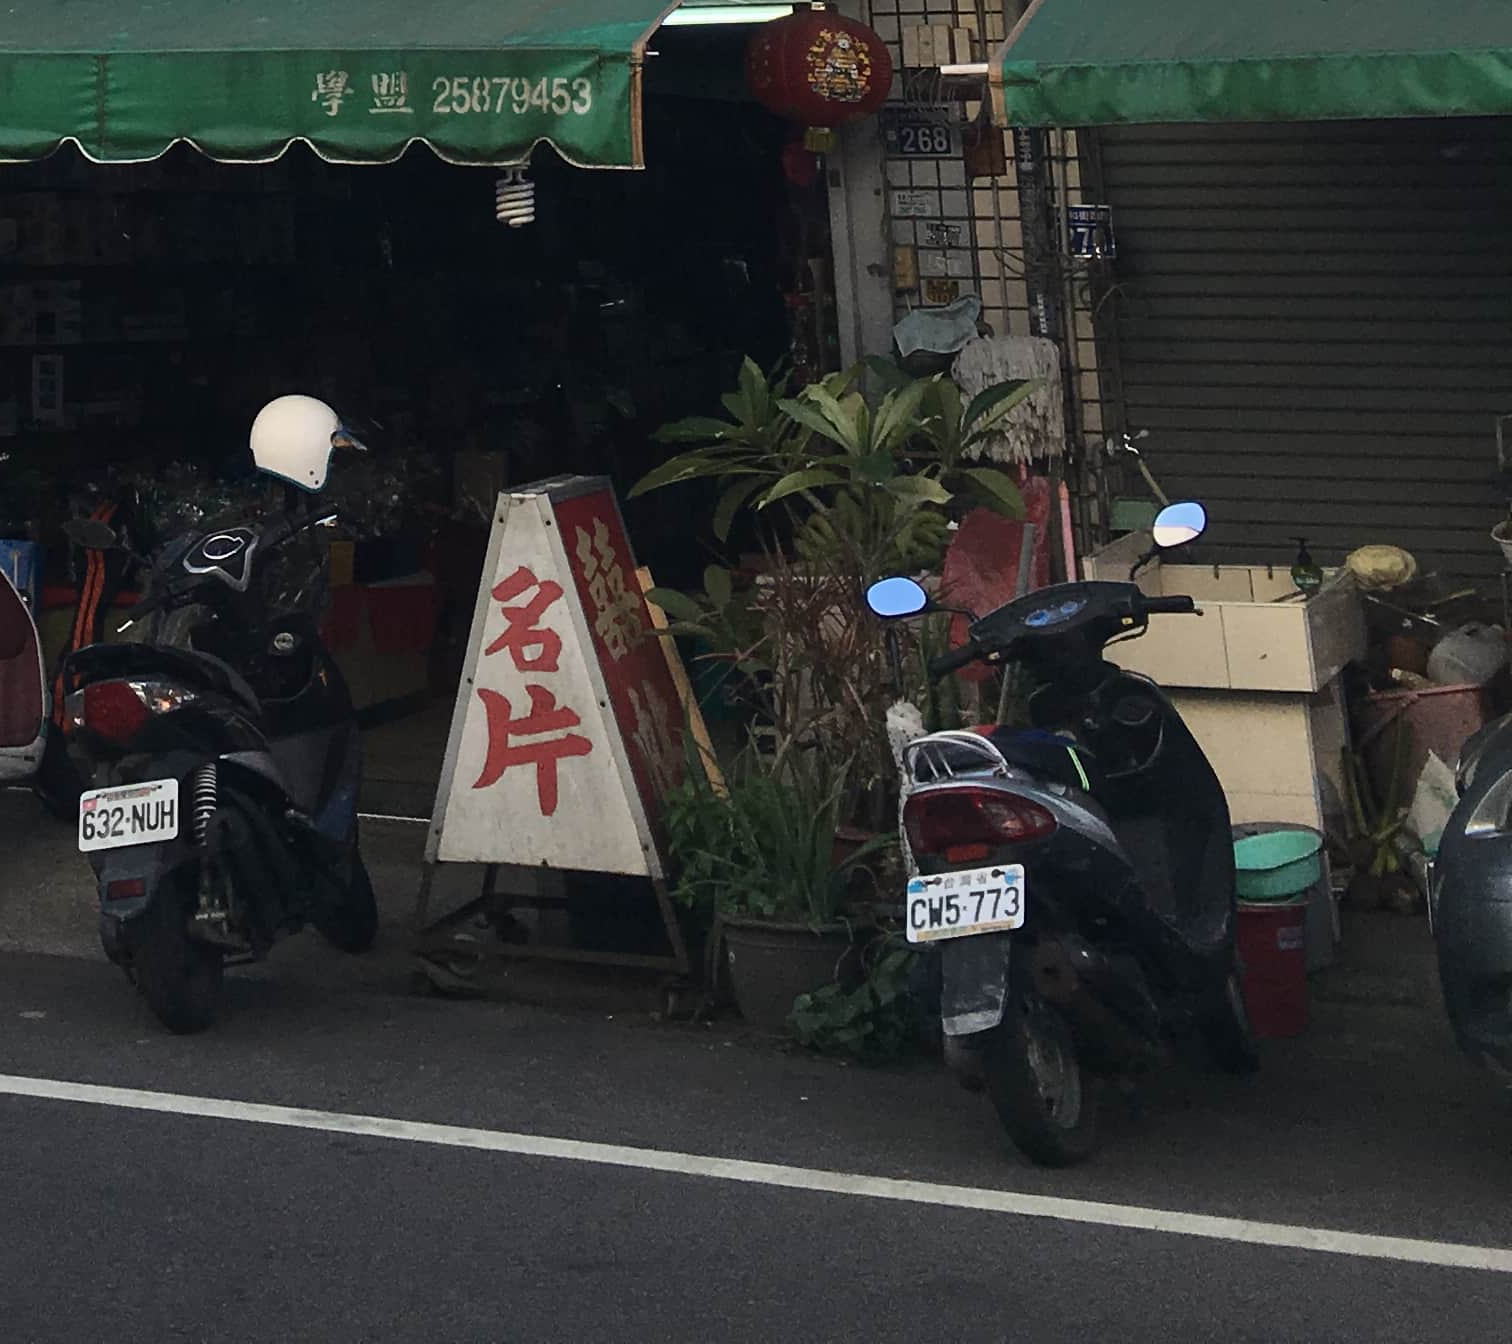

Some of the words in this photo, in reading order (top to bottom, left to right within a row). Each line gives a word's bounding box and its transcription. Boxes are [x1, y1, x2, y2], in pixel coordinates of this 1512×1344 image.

[431, 75, 593, 117] 25879453
[902, 126, 948, 153] 268
[472, 565, 592, 817] 名片
